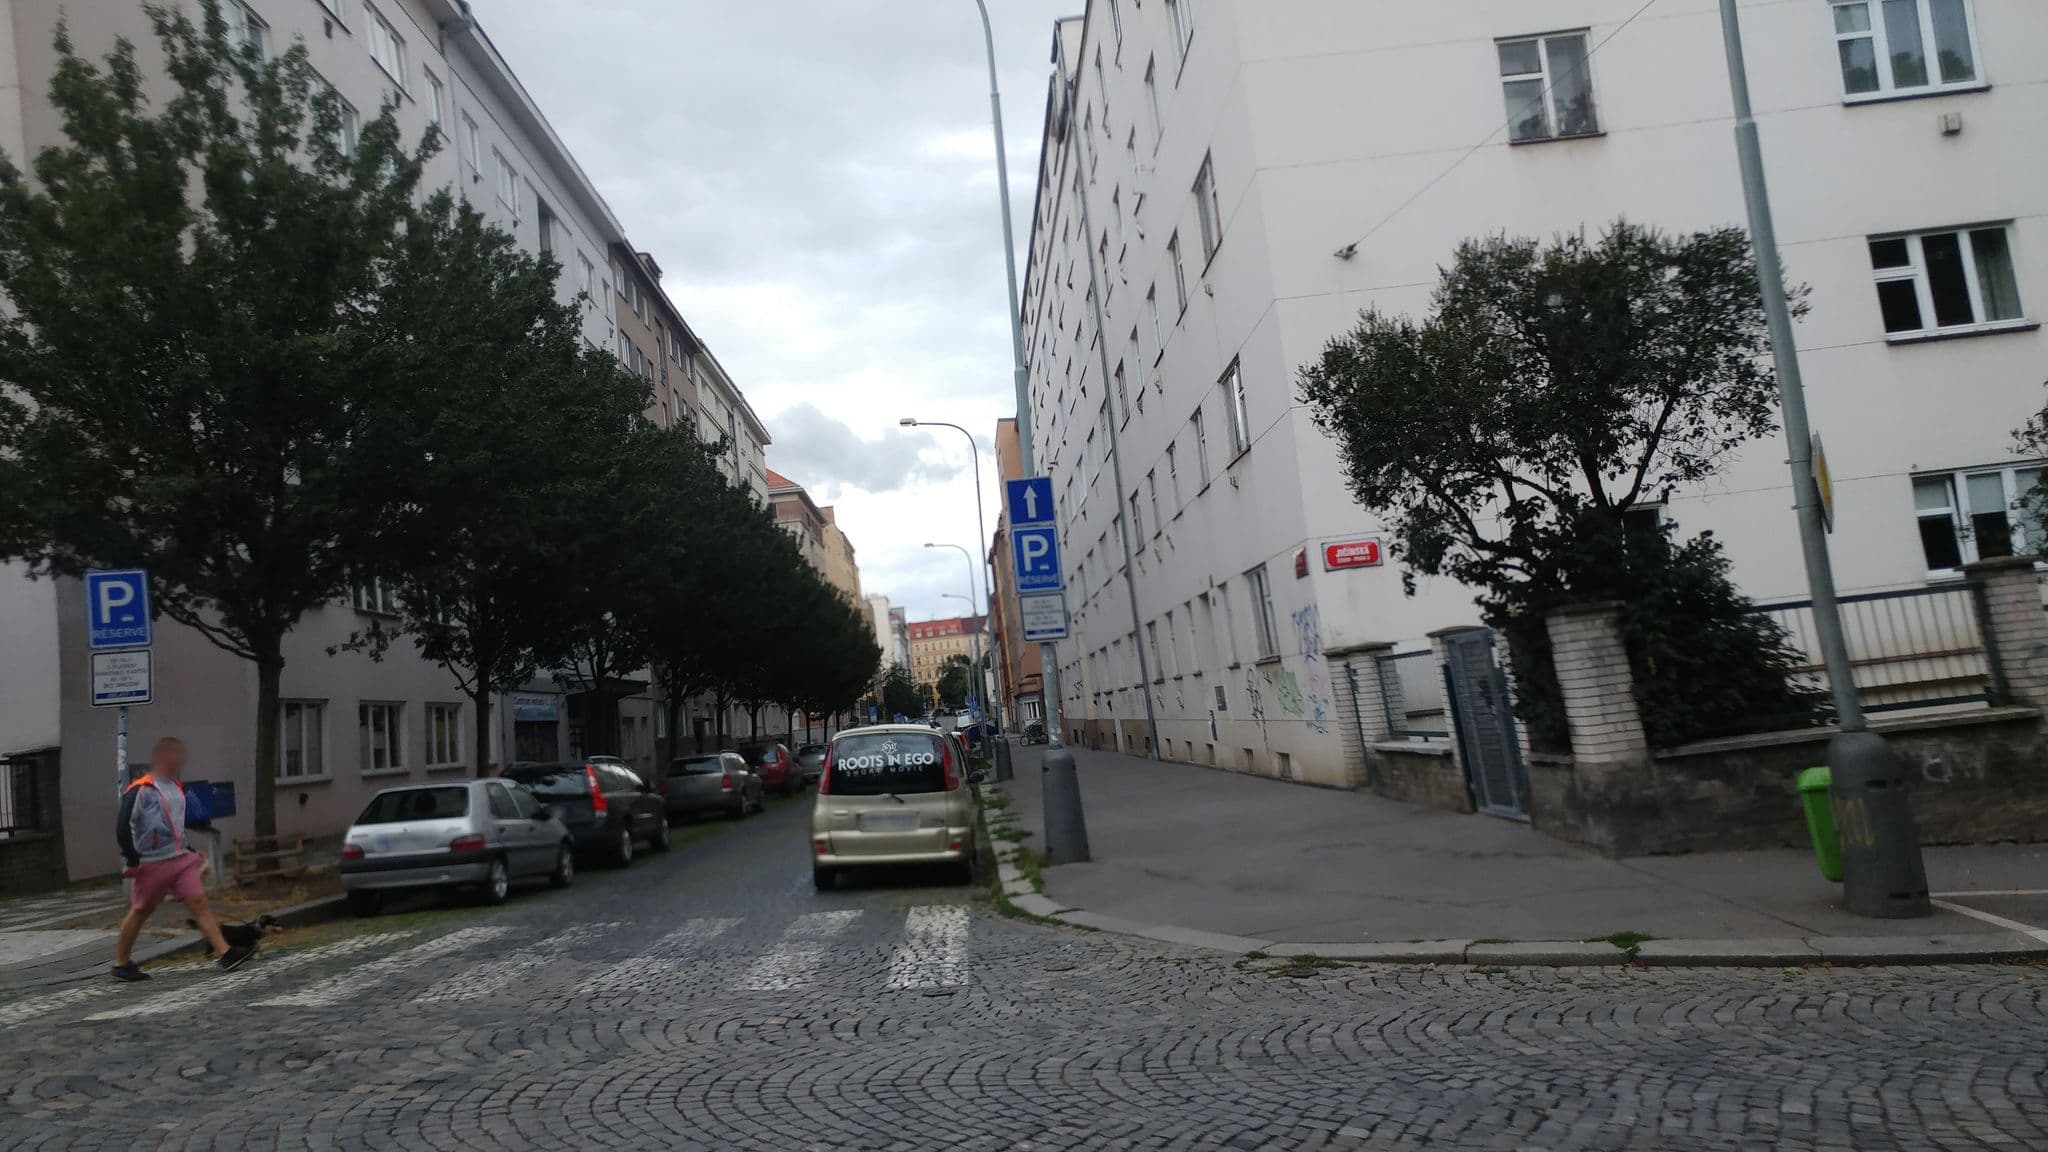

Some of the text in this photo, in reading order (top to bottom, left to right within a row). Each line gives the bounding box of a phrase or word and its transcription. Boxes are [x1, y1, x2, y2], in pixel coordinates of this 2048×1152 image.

[1021, 534, 1049, 572] P
[99, 580, 134, 624] P
[838, 752, 934, 771] ROOTS IN EGO
[846, 765, 923, 777] SHORT MOVIE
